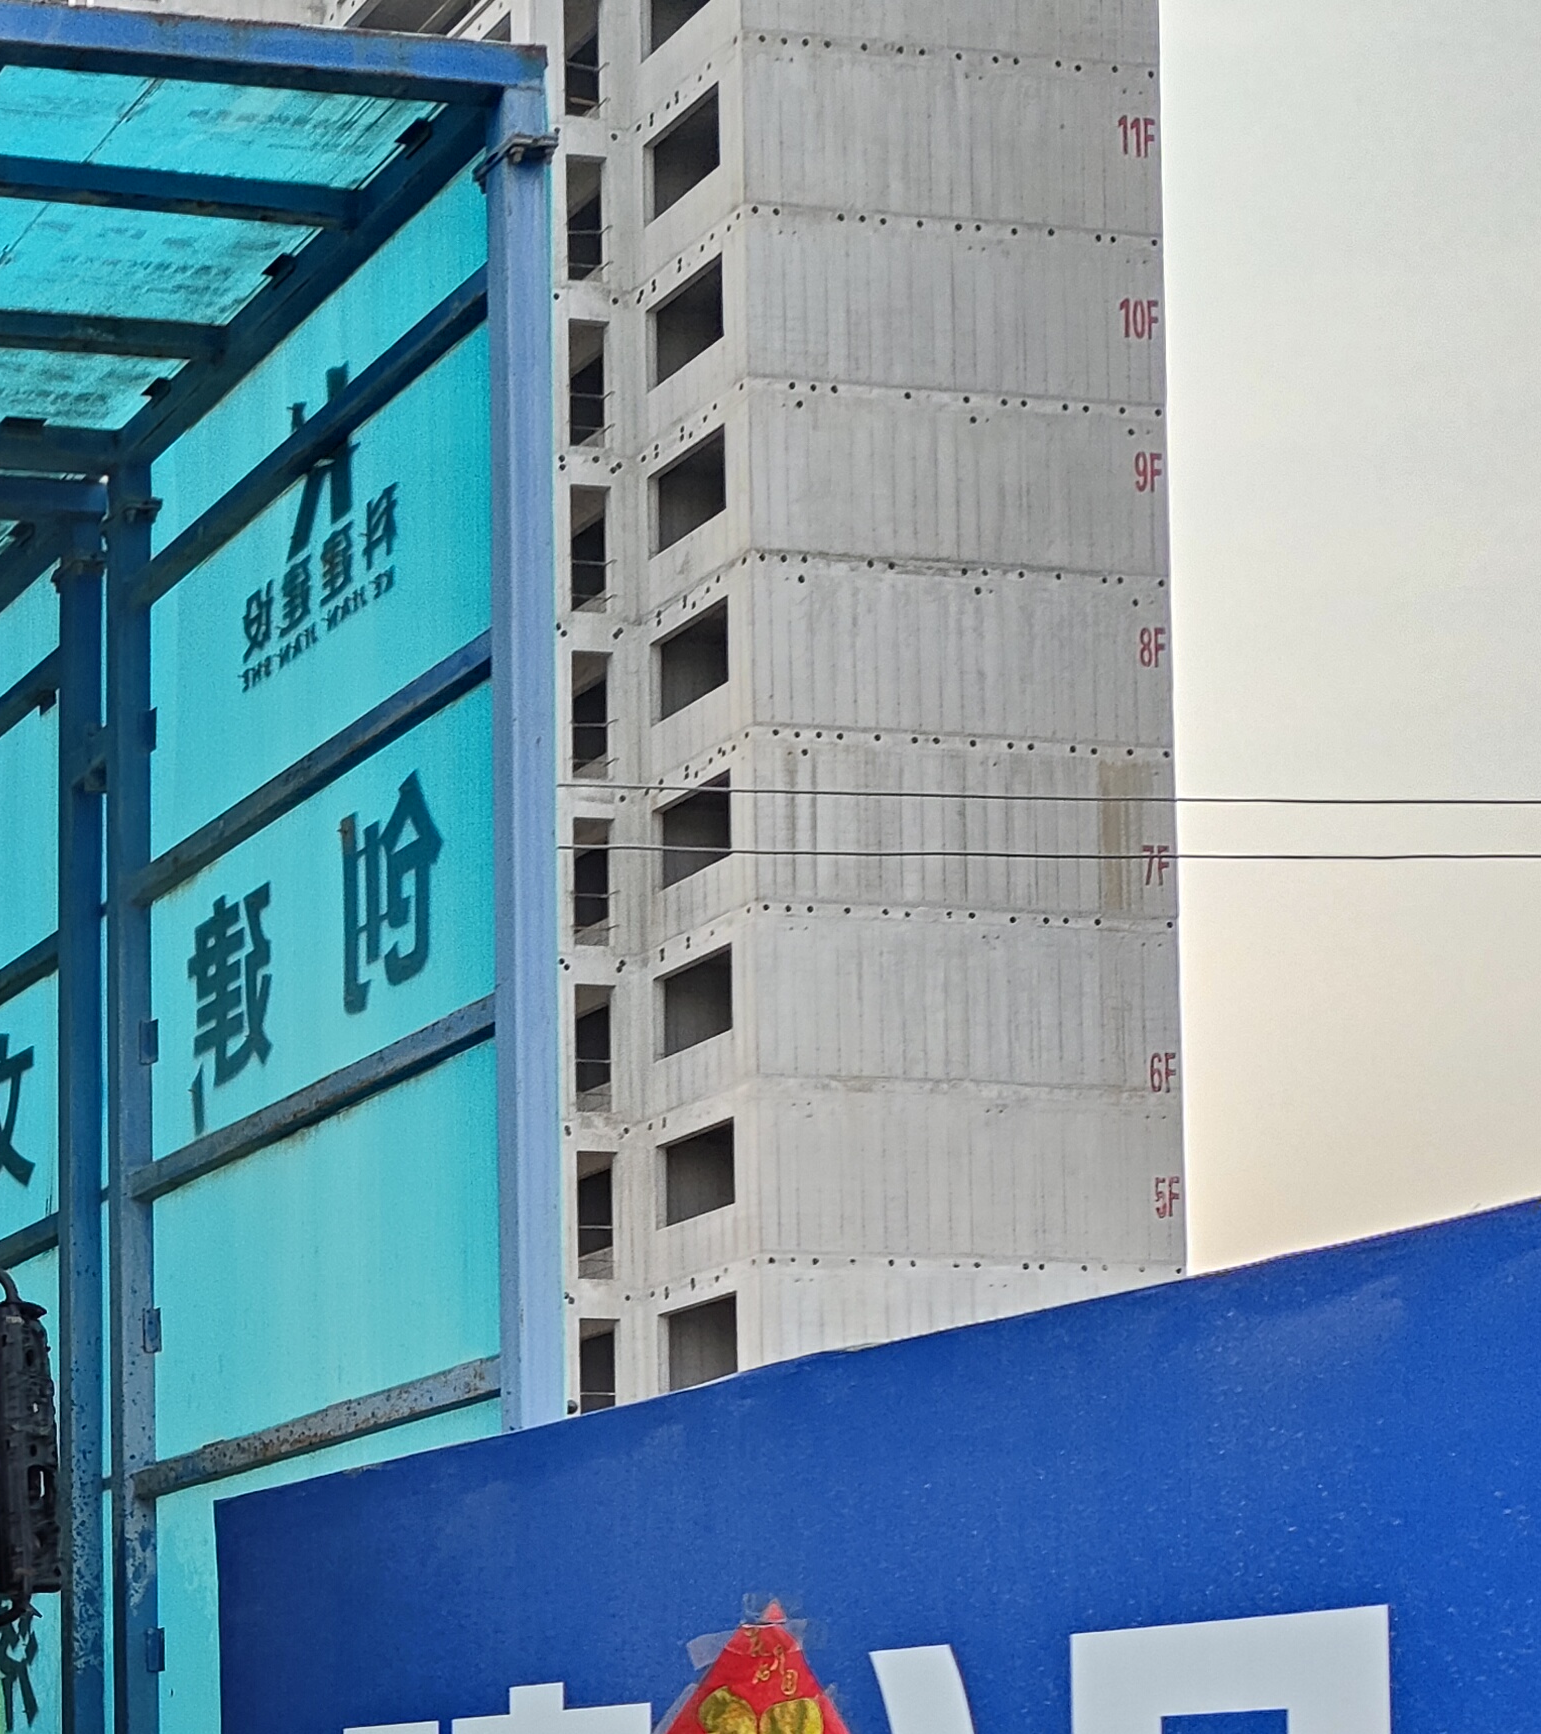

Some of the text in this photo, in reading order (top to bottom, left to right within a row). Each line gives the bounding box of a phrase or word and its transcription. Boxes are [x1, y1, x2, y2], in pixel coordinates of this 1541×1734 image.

[1117, 115, 1156, 158] 11F
[1119, 297, 1160, 341] 10F
[1134, 451, 1163, 493] 9F
[1139, 627, 1167, 669] 8F
[1142, 845, 1171, 888] 7F
[1149, 1052, 1177, 1094] 6F
[1154, 1176, 1181, 1219] 5F
